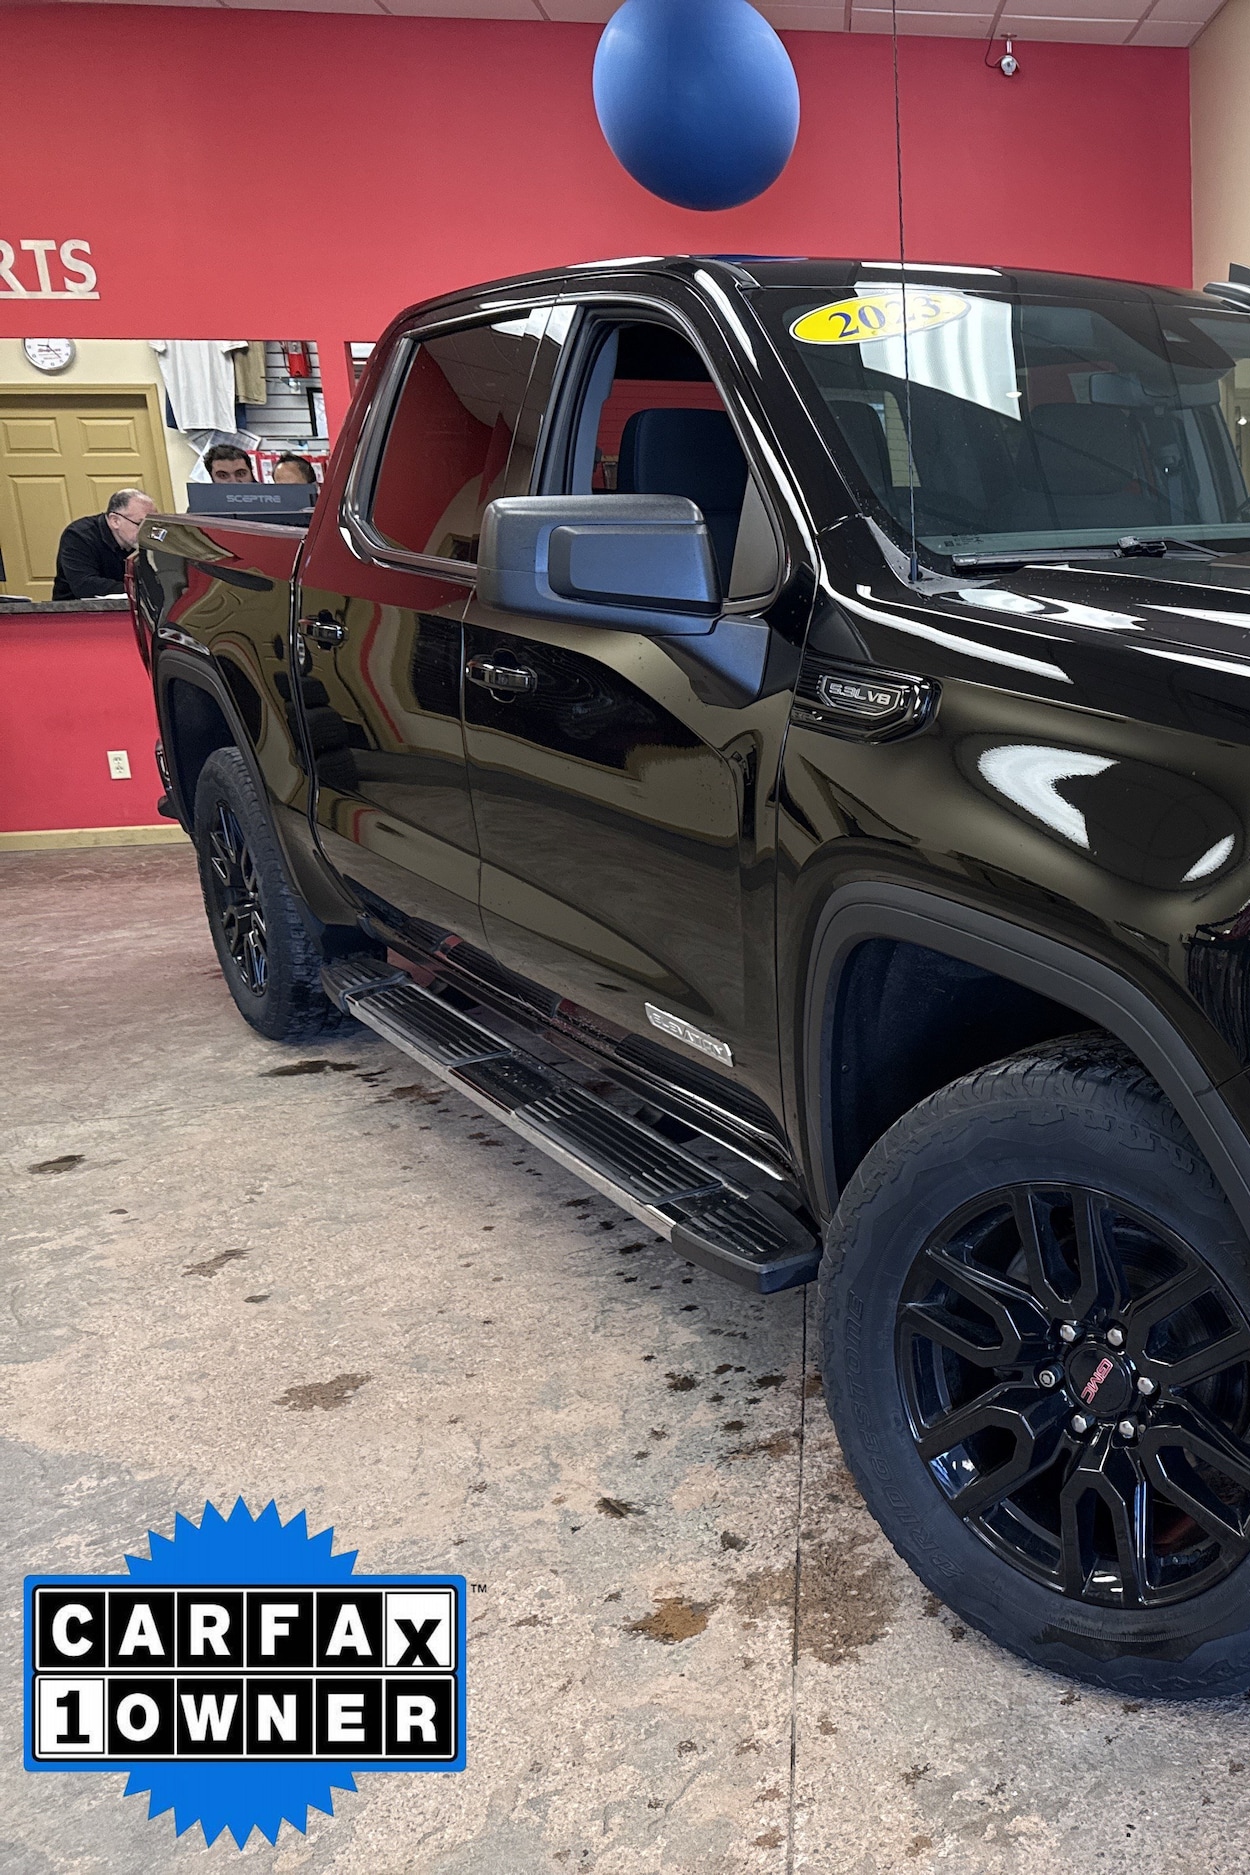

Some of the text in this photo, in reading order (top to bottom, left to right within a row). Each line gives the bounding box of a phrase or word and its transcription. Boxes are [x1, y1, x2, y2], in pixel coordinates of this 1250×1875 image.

[828, 294, 942, 338] 2023
[226, 494, 281, 503] SCEPTRE
[1081, 1357, 1113, 1404] GMC
[843, 1289, 966, 1578] BRIDGESTONE
